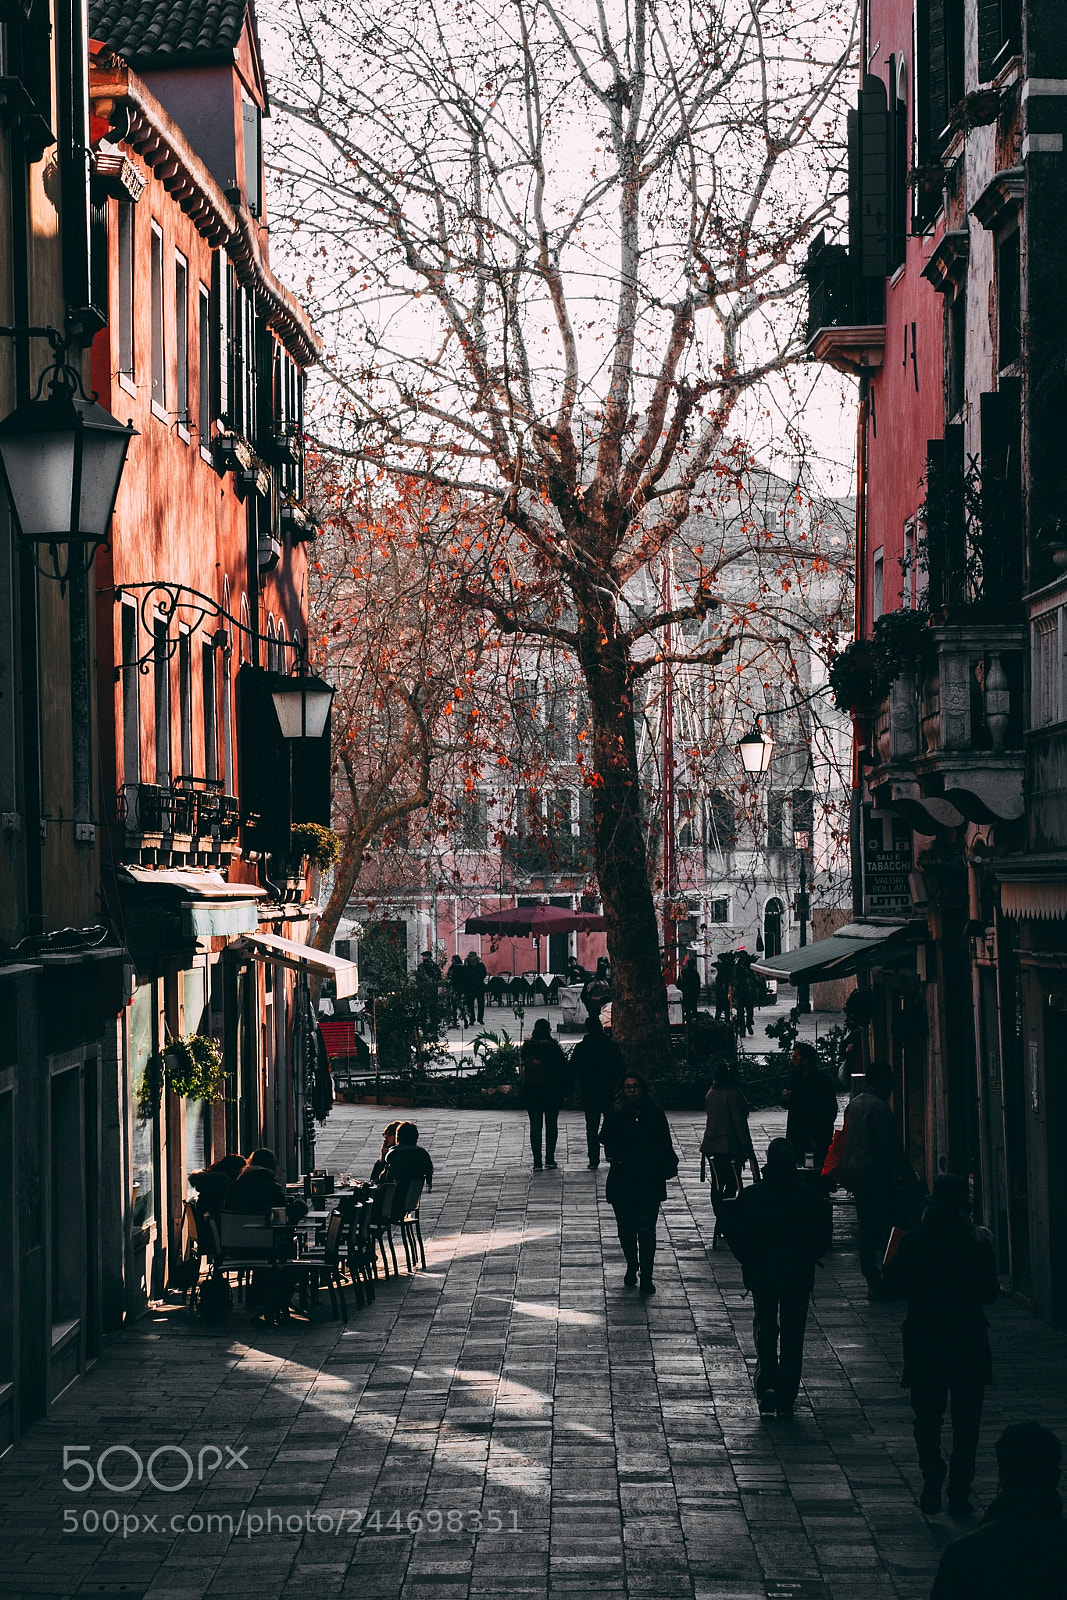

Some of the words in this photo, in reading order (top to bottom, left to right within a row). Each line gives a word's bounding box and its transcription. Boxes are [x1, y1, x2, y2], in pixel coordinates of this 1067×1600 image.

[866, 861, 911, 871] TABACCHI
[874, 876, 904, 885] VALORI
[872, 884, 906, 893] BOLLATI
[870, 896, 909, 906] LOTTO
